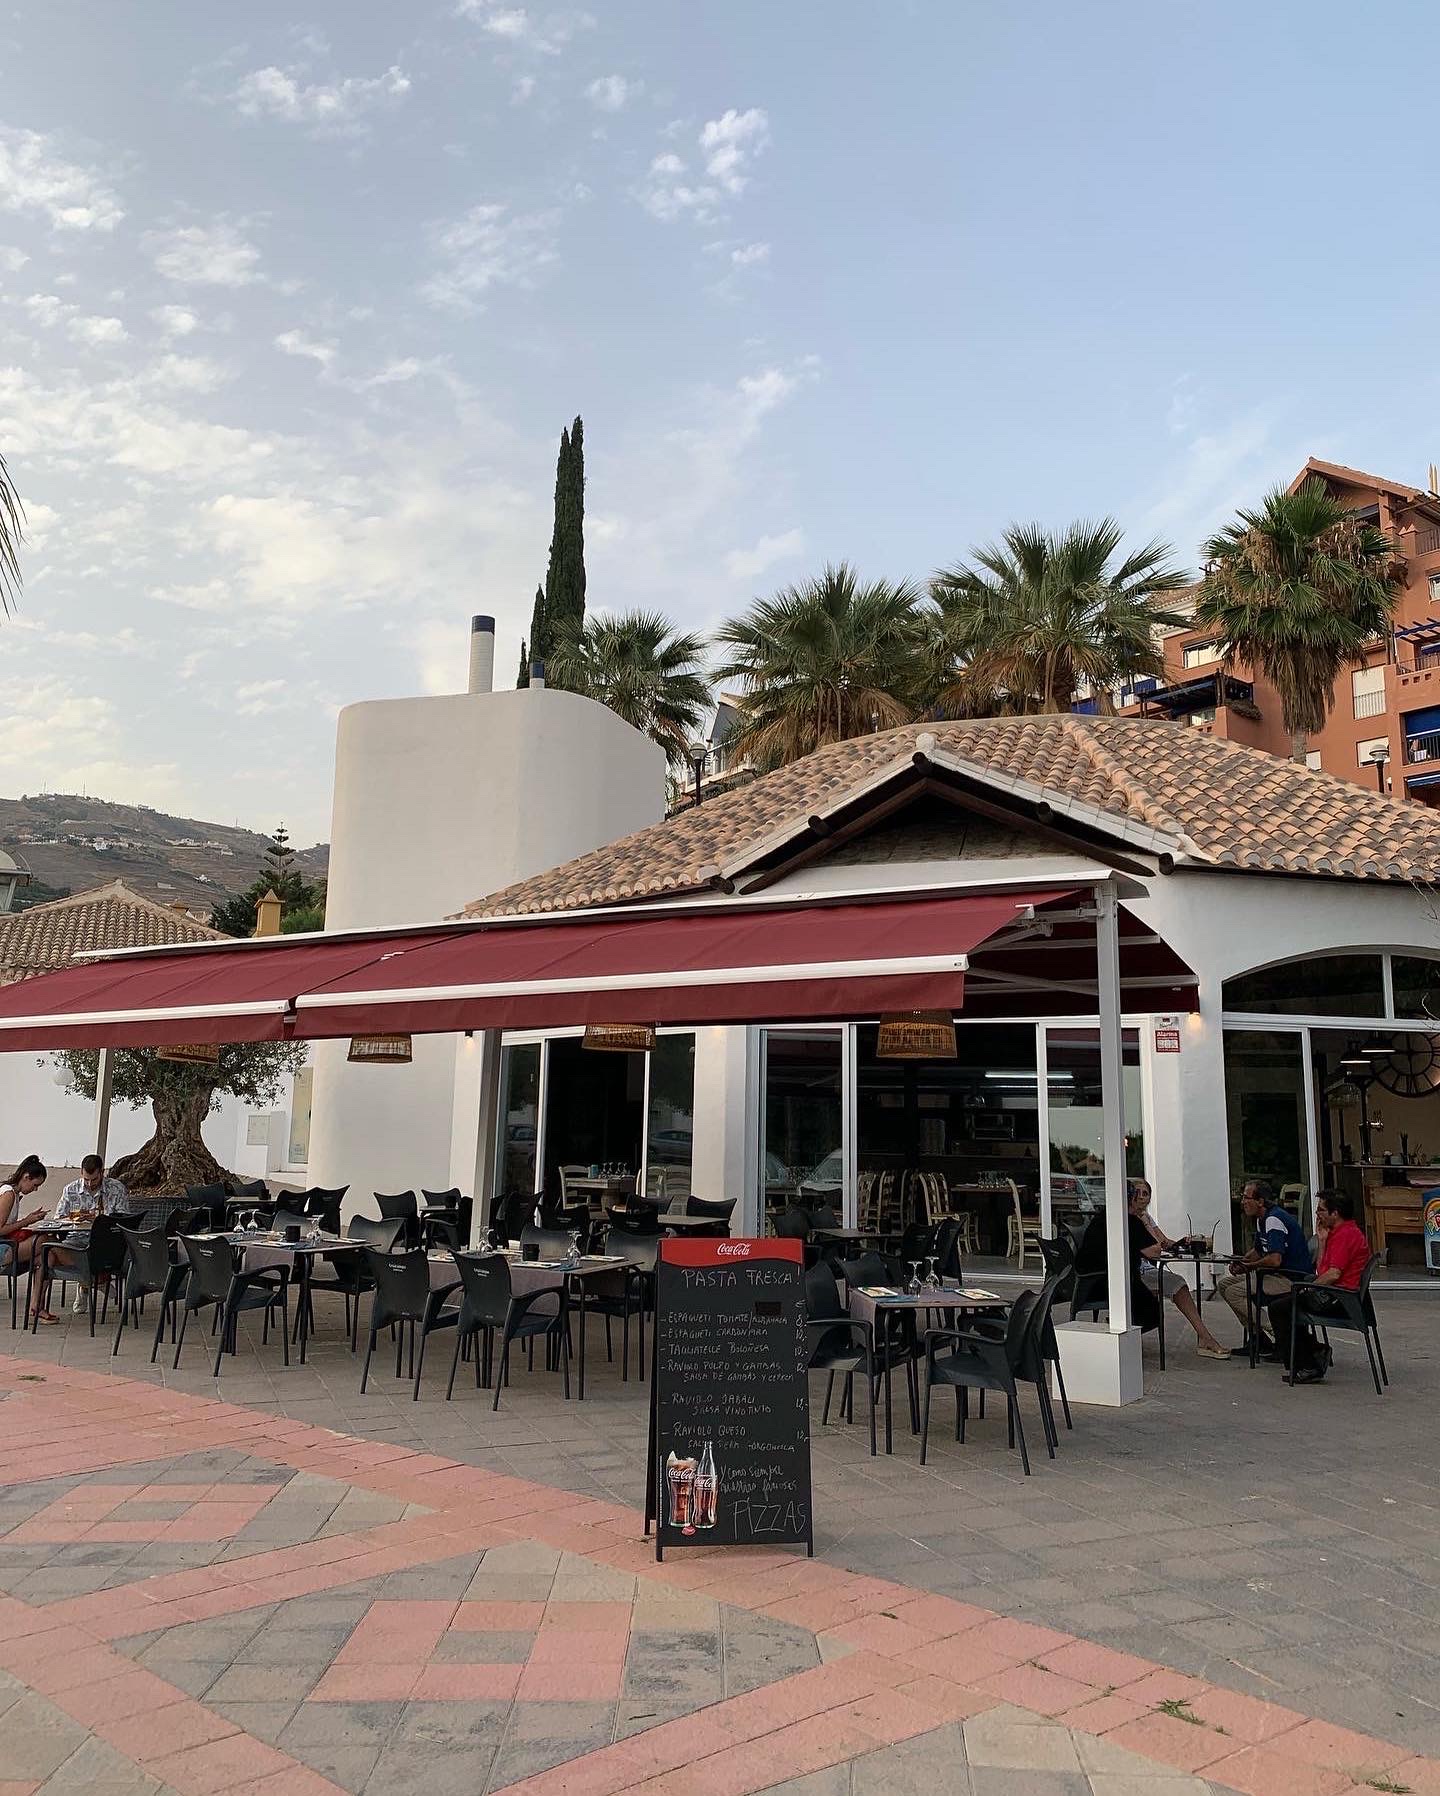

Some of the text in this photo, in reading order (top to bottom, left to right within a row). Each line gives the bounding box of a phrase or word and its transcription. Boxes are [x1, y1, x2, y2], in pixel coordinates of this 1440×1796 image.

[681, 1268, 737, 1289] PASTA
[673, 1421, 713, 1437] RAVIOLO
[718, 1424, 747, 1437] QUESO
[727, 1496, 806, 1540] PIZZAS
